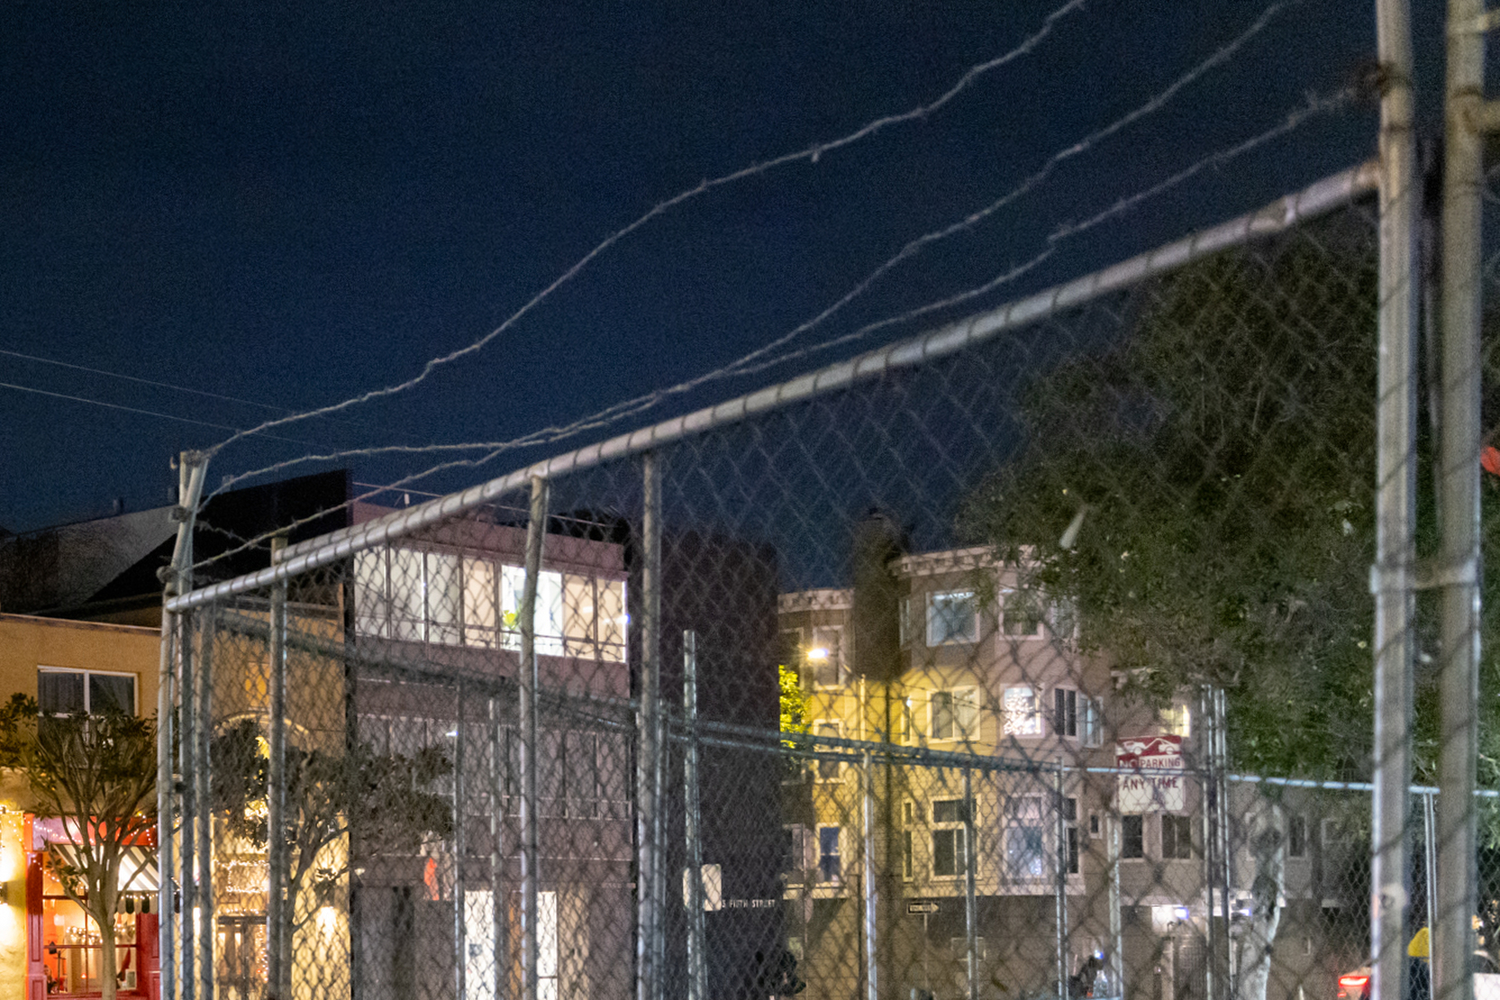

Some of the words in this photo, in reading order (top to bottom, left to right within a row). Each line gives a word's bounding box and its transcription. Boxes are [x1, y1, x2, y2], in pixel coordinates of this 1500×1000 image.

[1140, 757, 1181, 768] PARKING
[1123, 778, 1145, 790] ANY
[1150, 776, 1179, 789] TIME
